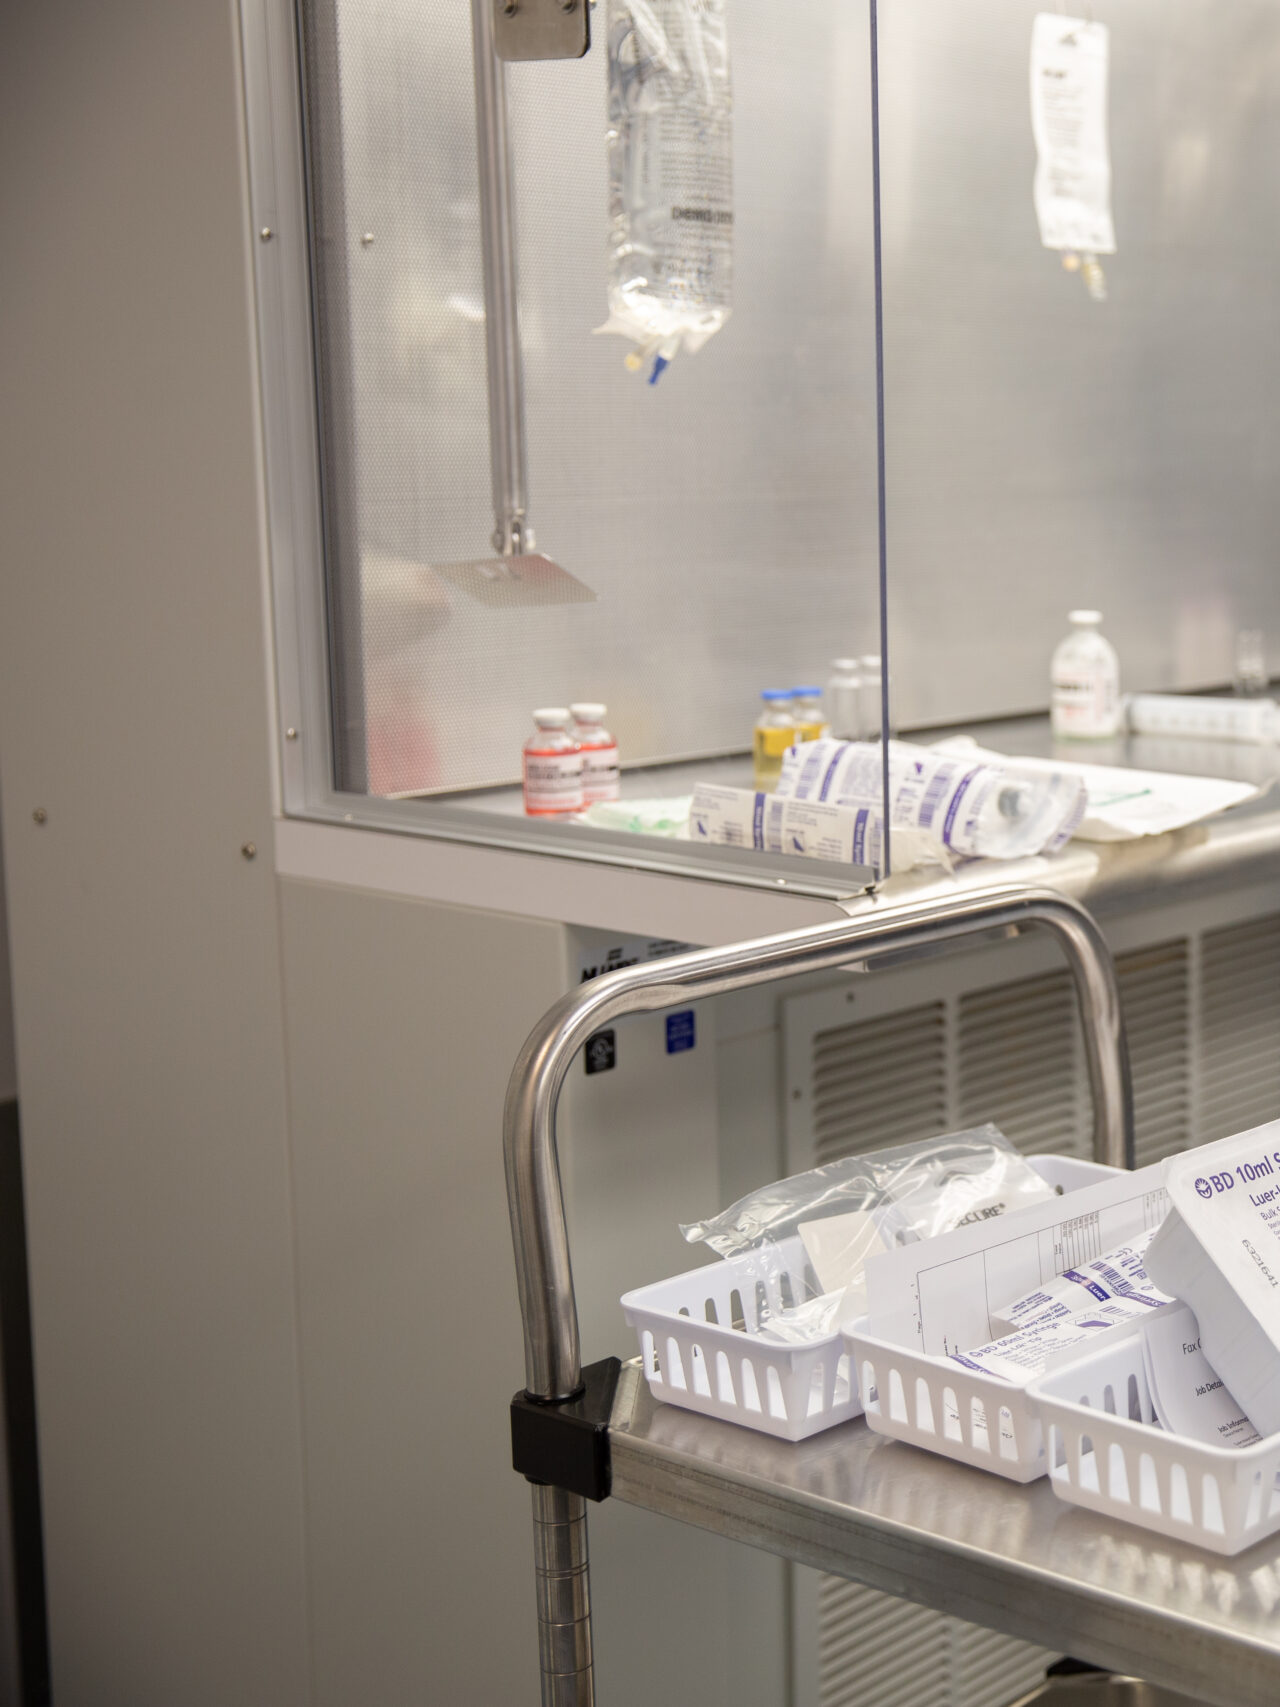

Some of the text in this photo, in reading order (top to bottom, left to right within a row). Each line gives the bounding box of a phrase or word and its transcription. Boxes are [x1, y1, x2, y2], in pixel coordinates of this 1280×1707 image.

[1209, 1172, 1234, 1193] BD
[1236, 1155, 1274, 1183] 10ml
[1260, 1208, 1278, 1221] Bulk
[1021, 1322, 1061, 1337] Syringe
[1182, 1343, 1197, 1355] Fax
[1195, 1385, 1206, 1396] Job
